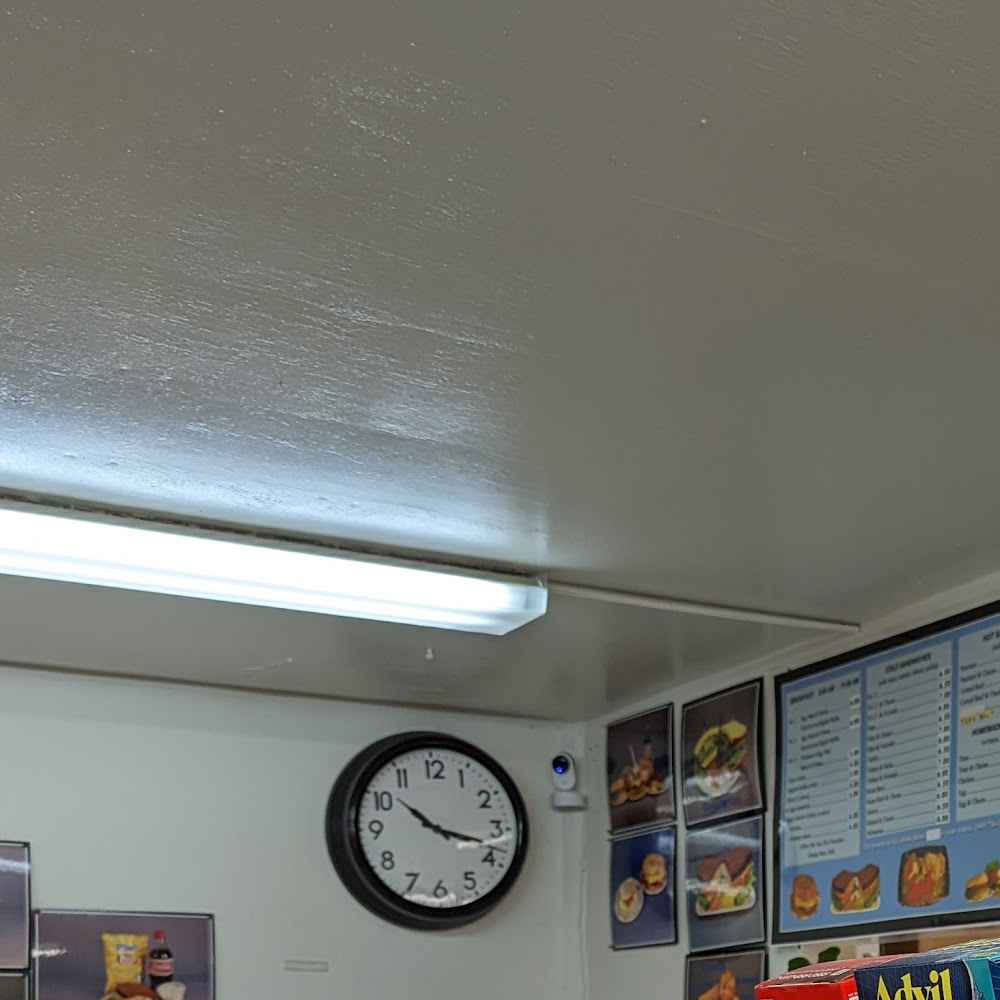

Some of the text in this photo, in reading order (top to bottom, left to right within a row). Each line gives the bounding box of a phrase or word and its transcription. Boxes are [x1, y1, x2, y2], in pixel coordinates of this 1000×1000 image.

[396, 768, 408, 789] 11
[424, 759, 446, 780] 12
[458, 768, 465, 788] 1
[374, 790, 393, 811] 10
[477, 789, 492, 809] 2
[368, 819, 384, 840] 9
[489, 819, 504, 839] 3
[381, 850, 396, 870] 8
[481, 849, 496, 867] 4
[405, 872, 420, 892] 7
[433, 880, 448, 899] 6
[463, 871, 477, 890] 5
